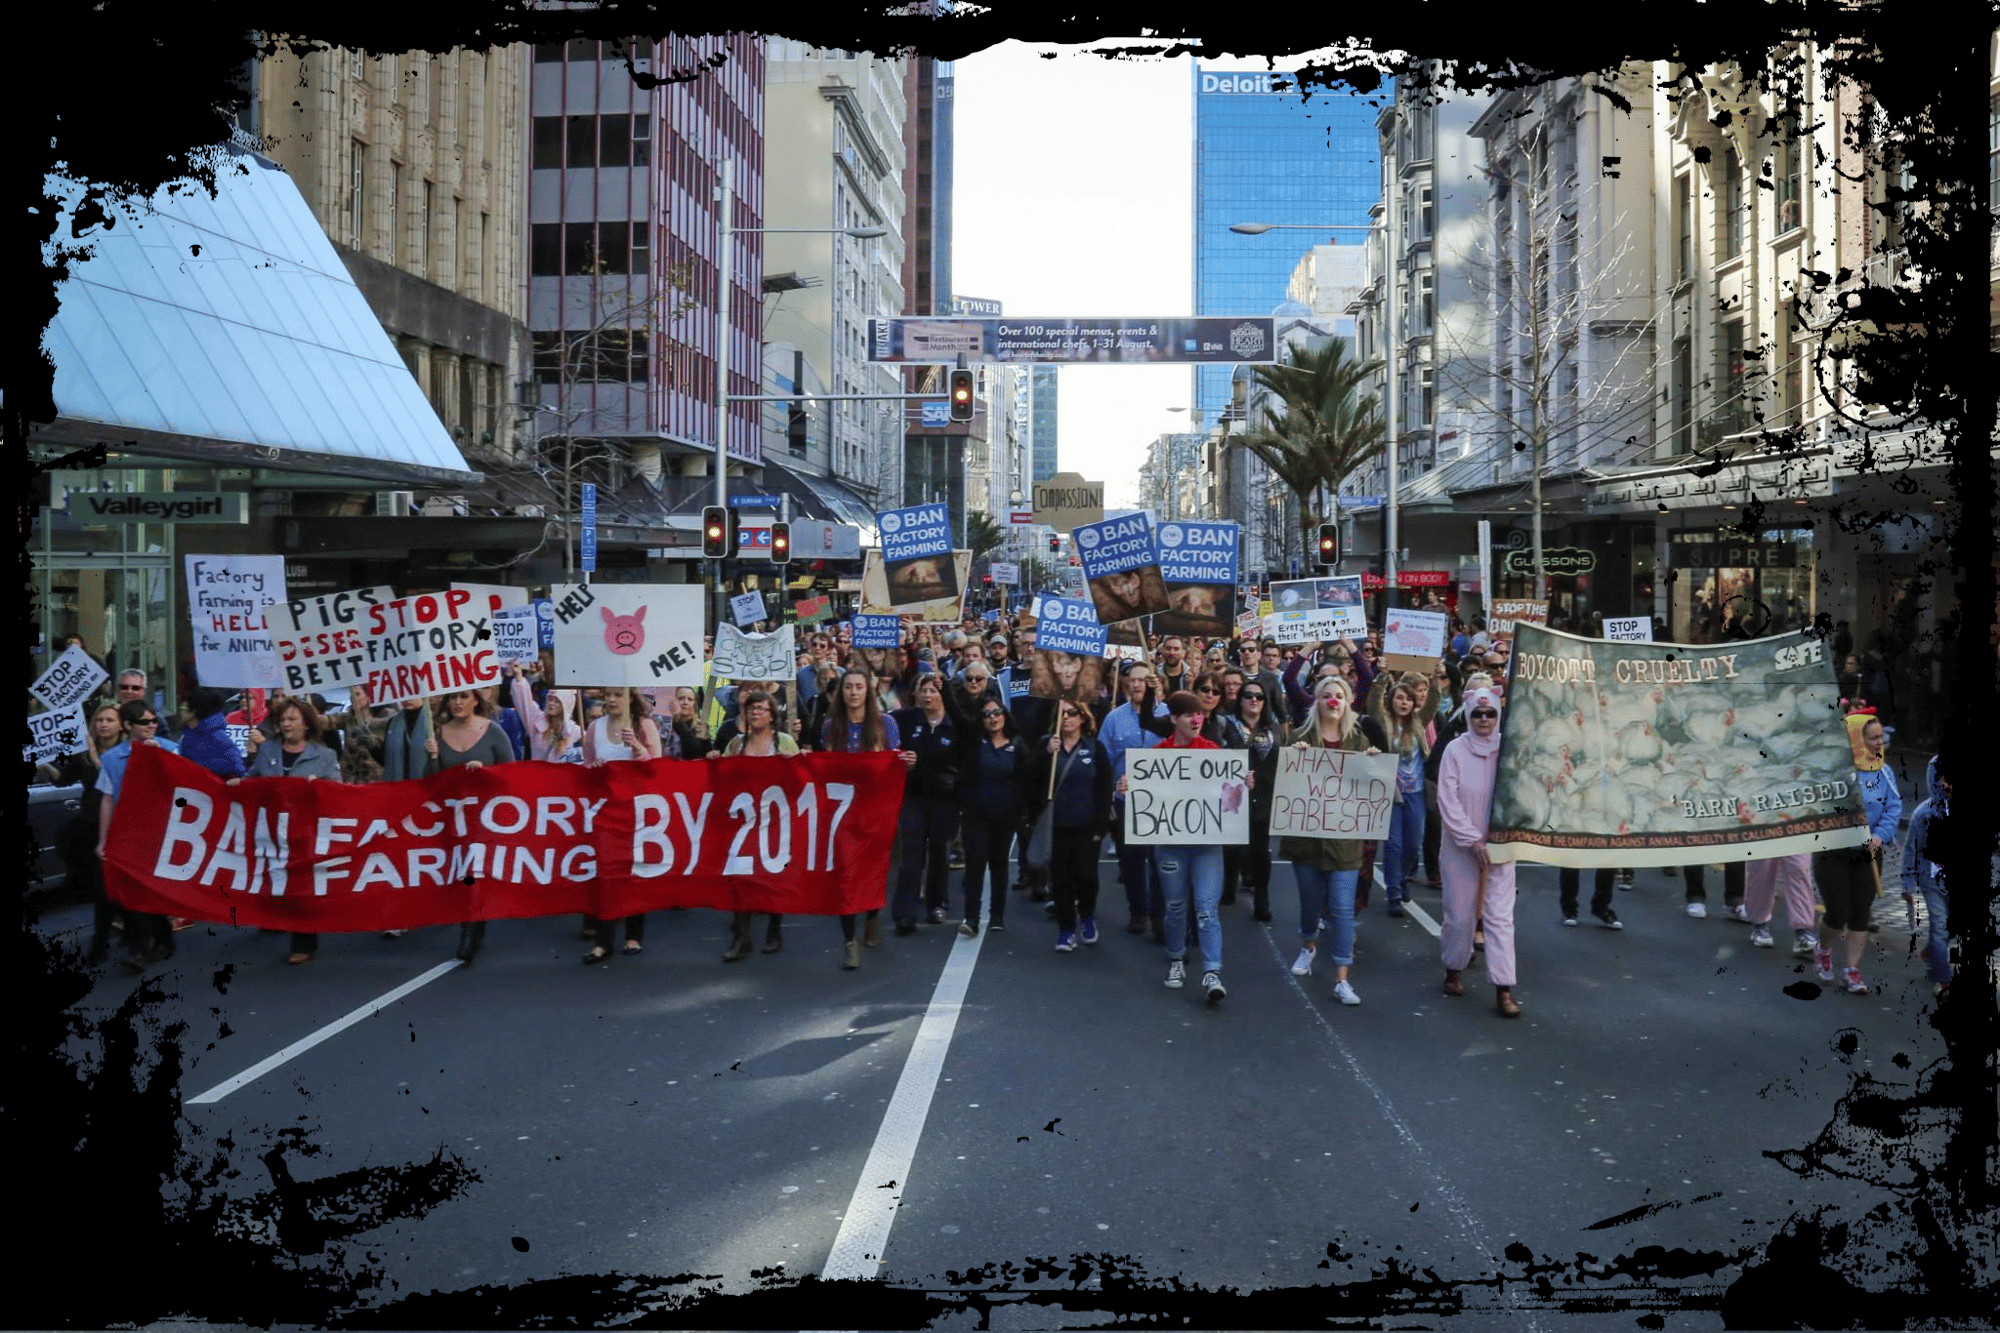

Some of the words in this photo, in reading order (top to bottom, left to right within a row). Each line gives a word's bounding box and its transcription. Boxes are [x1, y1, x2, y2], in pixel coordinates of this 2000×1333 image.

[998, 325, 1022, 336] Over
[1024, 325, 1044, 336] 100
[1046, 325, 1079, 339] special
[1081, 328, 1114, 337] menus,
[1117, 327, 1147, 336] events
[1149, 325, 1158, 336] &
[998, 339, 1060, 349] international
[1115, 339, 1154, 351] August.
[88, 497, 222, 519] Valleygirl
[904, 508, 943, 528] BAN
[740, 533, 749, 543] P
[884, 526, 946, 546] FACTORY
[1102, 518, 1146, 541] BAN
[1187, 528, 1234, 546] BAN
[886, 540, 947, 559] FARMING
[1084, 537, 1149, 562] FACTORY
[1160, 549, 1233, 563] FACTORY
[1089, 551, 1152, 576] FARMING
[1160, 565, 1231, 580] FARMING
[194, 561, 264, 591] Factory
[198, 590, 253, 615] Farming
[261, 593, 276, 606] is
[555, 583, 595, 625] HELP
[737, 595, 755, 606] STOP
[1496, 603, 1524, 614] STOP
[1526, 603, 1547, 615] THE
[369, 589, 471, 635] STOP
[870, 618, 896, 627] BAN
[493, 622, 524, 636] STOP
[855, 629, 897, 637] FACTORY
[1041, 620, 1104, 639] FACTORY
[1277, 631, 1297, 641] their
[1278, 623, 1304, 634] Every
[1610, 621, 1638, 632] STOP
[200, 635, 220, 652] for
[367, 617, 487, 662] FACTORY
[720, 637, 787, 657] CRUELTY
[855, 638, 896, 646] FARMING
[1040, 635, 1101, 654] FARMING
[713, 650, 793, 677] STOP!
[1774, 639, 1823, 671] SAFE
[37, 661, 72, 697] STOP
[285, 655, 363, 690] BETT
[1517, 652, 1596, 684] BOYCOTT
[1616, 654, 1740, 684] CRUELTY
[49, 662, 90, 706] FACTORY
[30, 713, 65, 735] TOP
[1133, 756, 1191, 780] SAVE
[1200, 759, 1246, 779] OUR
[1285, 750, 1356, 775] WHAT
[1308, 775, 1386, 803] WOULD
[1131, 789, 1223, 837] BACON
[314, 796, 607, 855] FACTORY
[631, 792, 714, 878] BY
[722, 782, 856, 875] 2017
[1611, 836, 1646, 847] AGAINST
[1648, 835, 1684, 846] ANIMAL
[1686, 833, 1726, 846] CRUELTY
[1727, 832, 1739, 843] BY
[1742, 825, 1783, 841] CALLING
[1786, 821, 1816, 835] 0800
[1819, 816, 1849, 831] SAVE
[153, 786, 290, 896] BAN
[313, 842, 598, 896] FARMING
